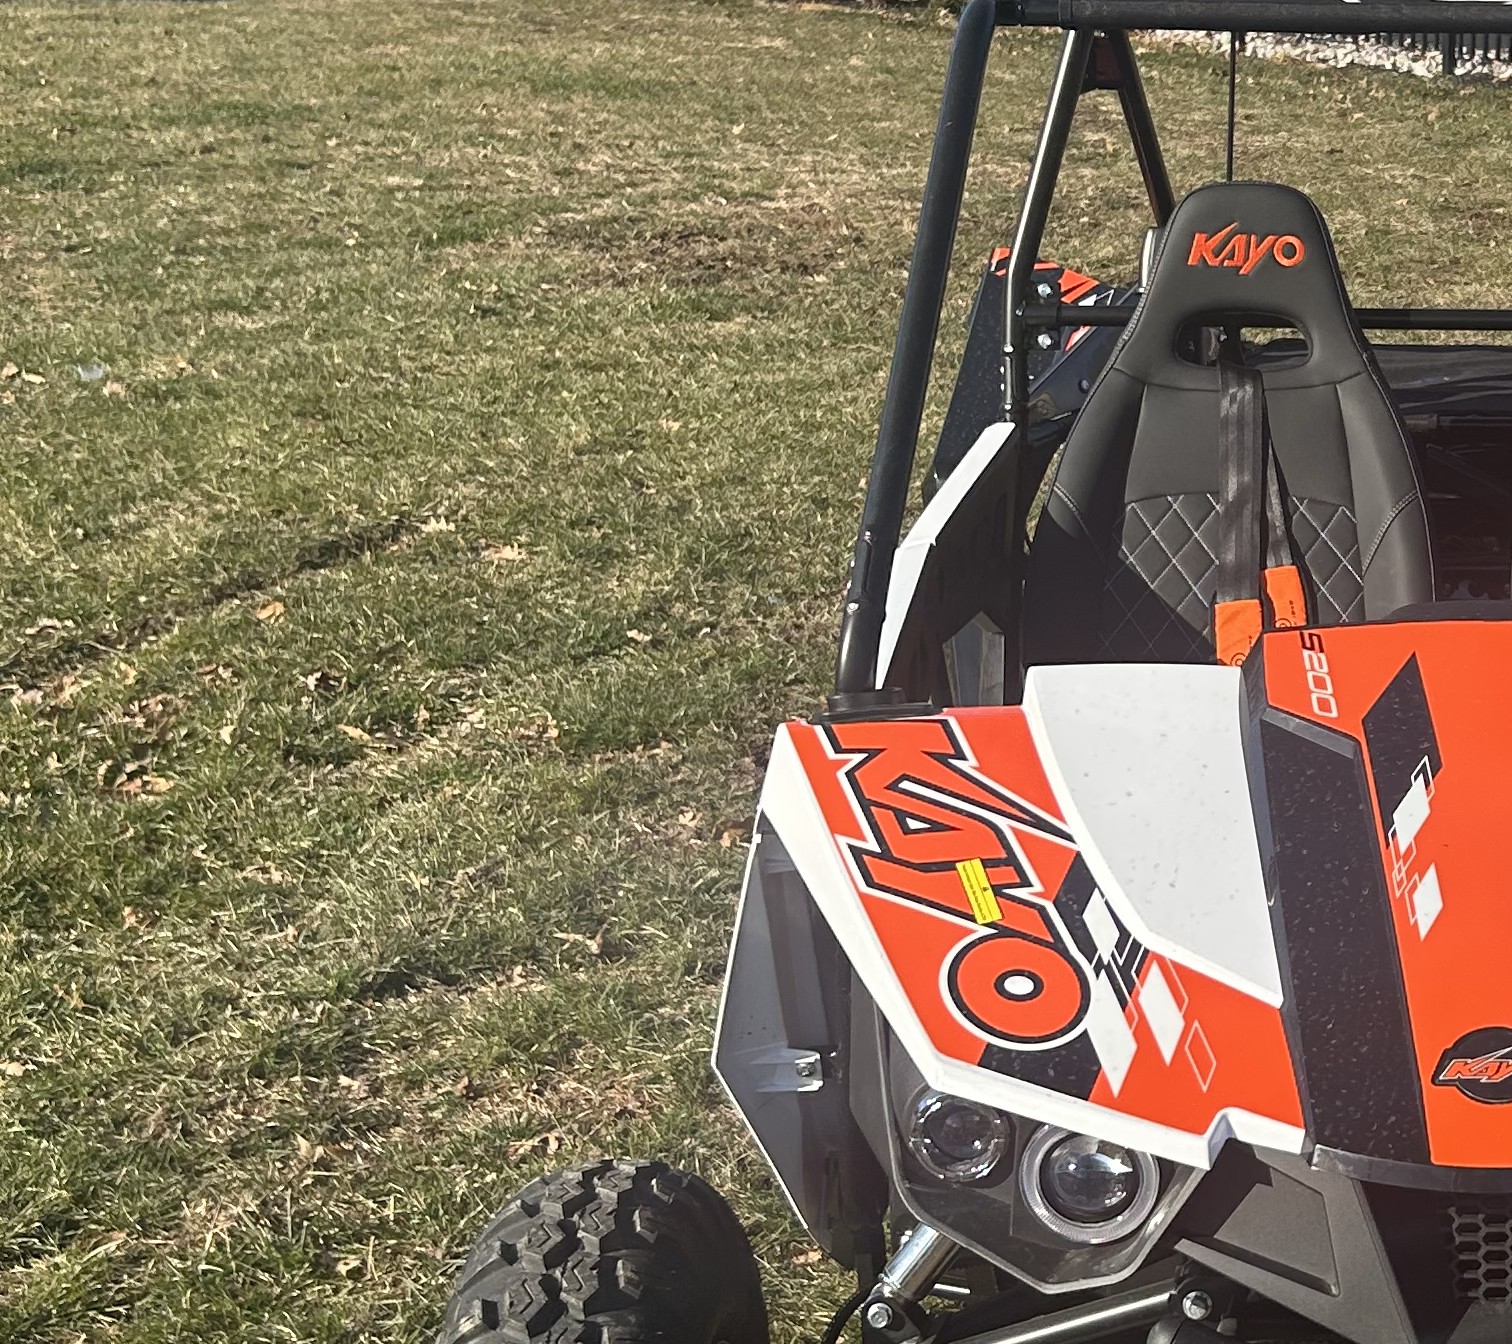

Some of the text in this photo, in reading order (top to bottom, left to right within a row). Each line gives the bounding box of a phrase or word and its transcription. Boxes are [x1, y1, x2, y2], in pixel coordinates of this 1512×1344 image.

[1187, 222, 1305, 275] KAYO
[1300, 630, 1339, 719] S200
[819, 719, 1091, 1045] KAYO
